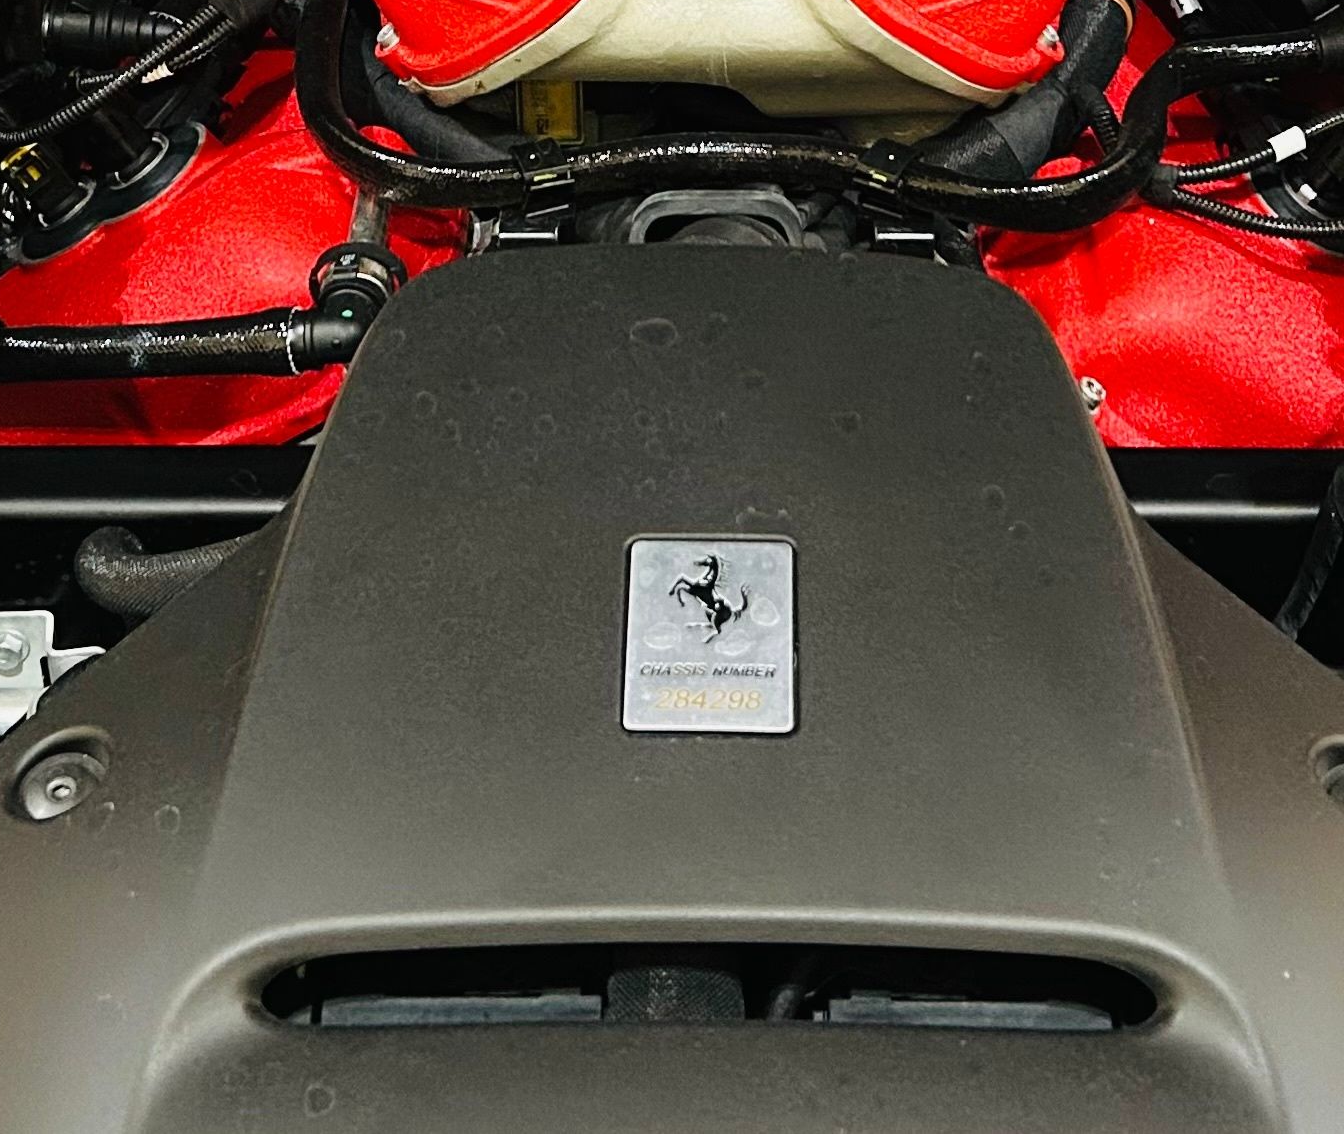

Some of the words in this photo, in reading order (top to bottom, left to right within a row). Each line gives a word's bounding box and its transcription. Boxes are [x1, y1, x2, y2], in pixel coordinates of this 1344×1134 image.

[640, 662, 706, 677] CHASSIS
[712, 663, 777, 678] NUMBER
[655, 689, 763, 710] 284298
